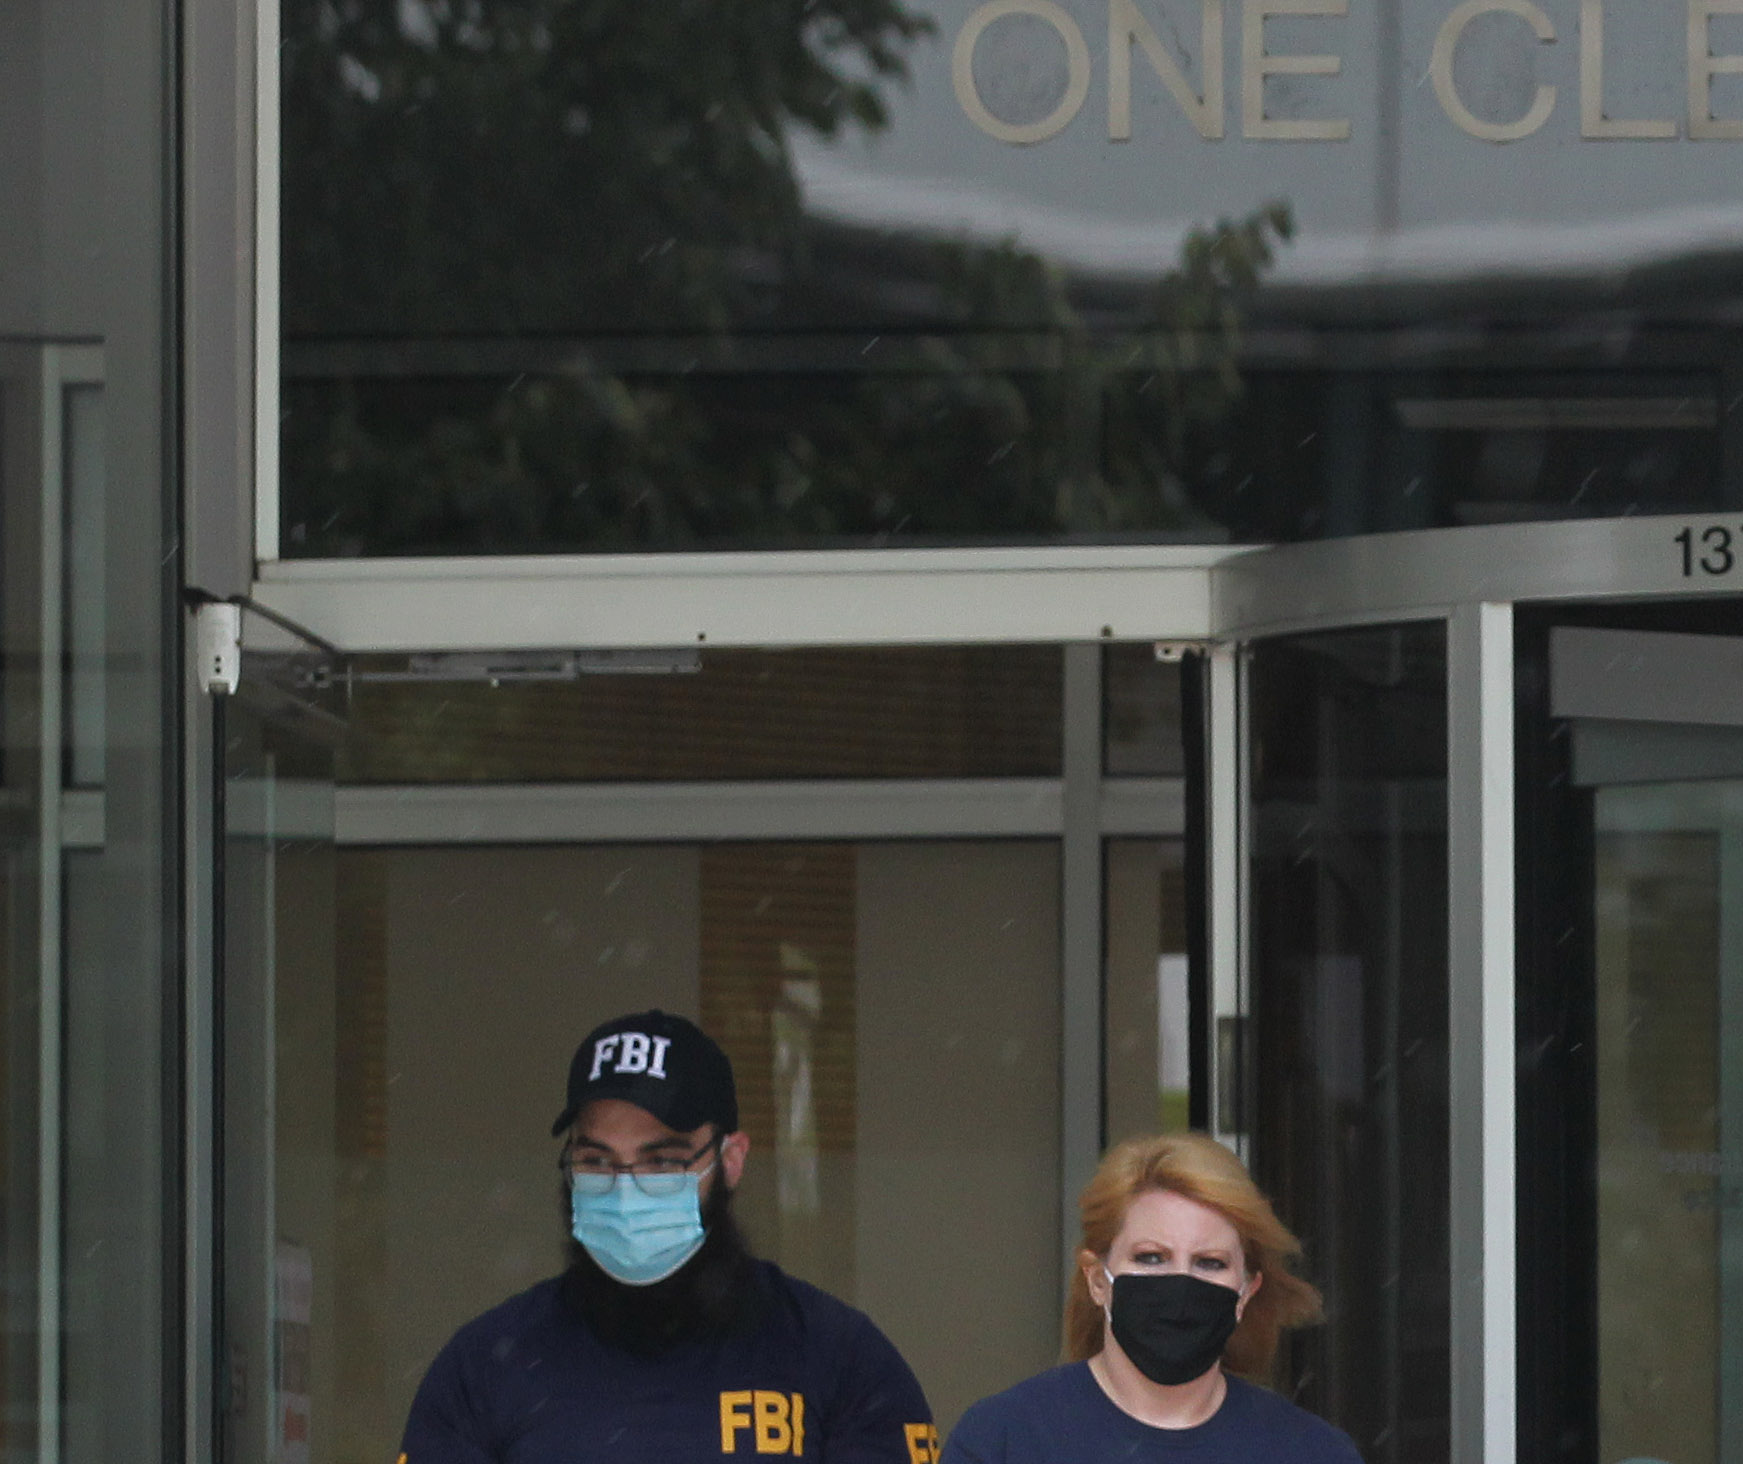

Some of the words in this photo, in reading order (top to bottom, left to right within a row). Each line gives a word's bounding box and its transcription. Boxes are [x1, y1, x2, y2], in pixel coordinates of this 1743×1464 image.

[951, 0, 1350, 145] ONE
[588, 1031, 672, 1082] FBI
[719, 1389, 804, 1457] FBI
